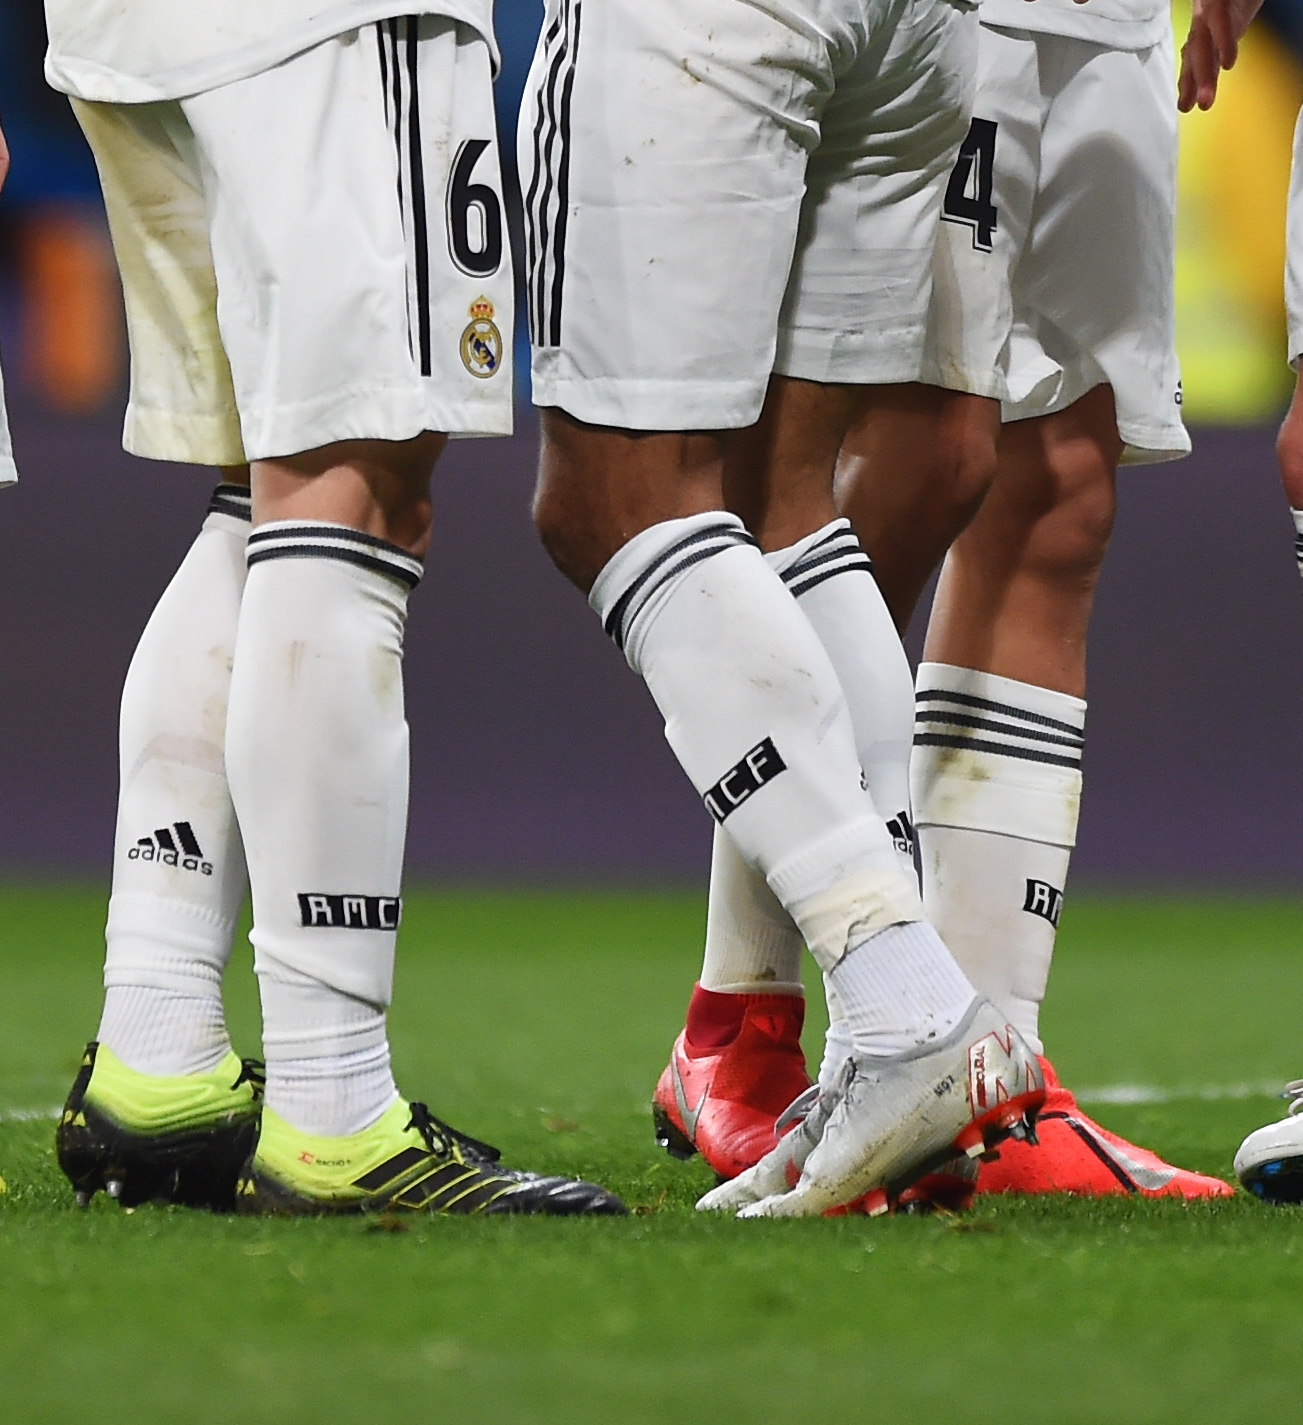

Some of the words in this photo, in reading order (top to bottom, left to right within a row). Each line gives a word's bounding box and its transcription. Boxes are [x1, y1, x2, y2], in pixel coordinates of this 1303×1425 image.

[444, 139, 503, 279] 6
[939, 116, 999, 254] 4
[127, 845, 214, 876] adidas
[307, 895, 402, 929] RMC
